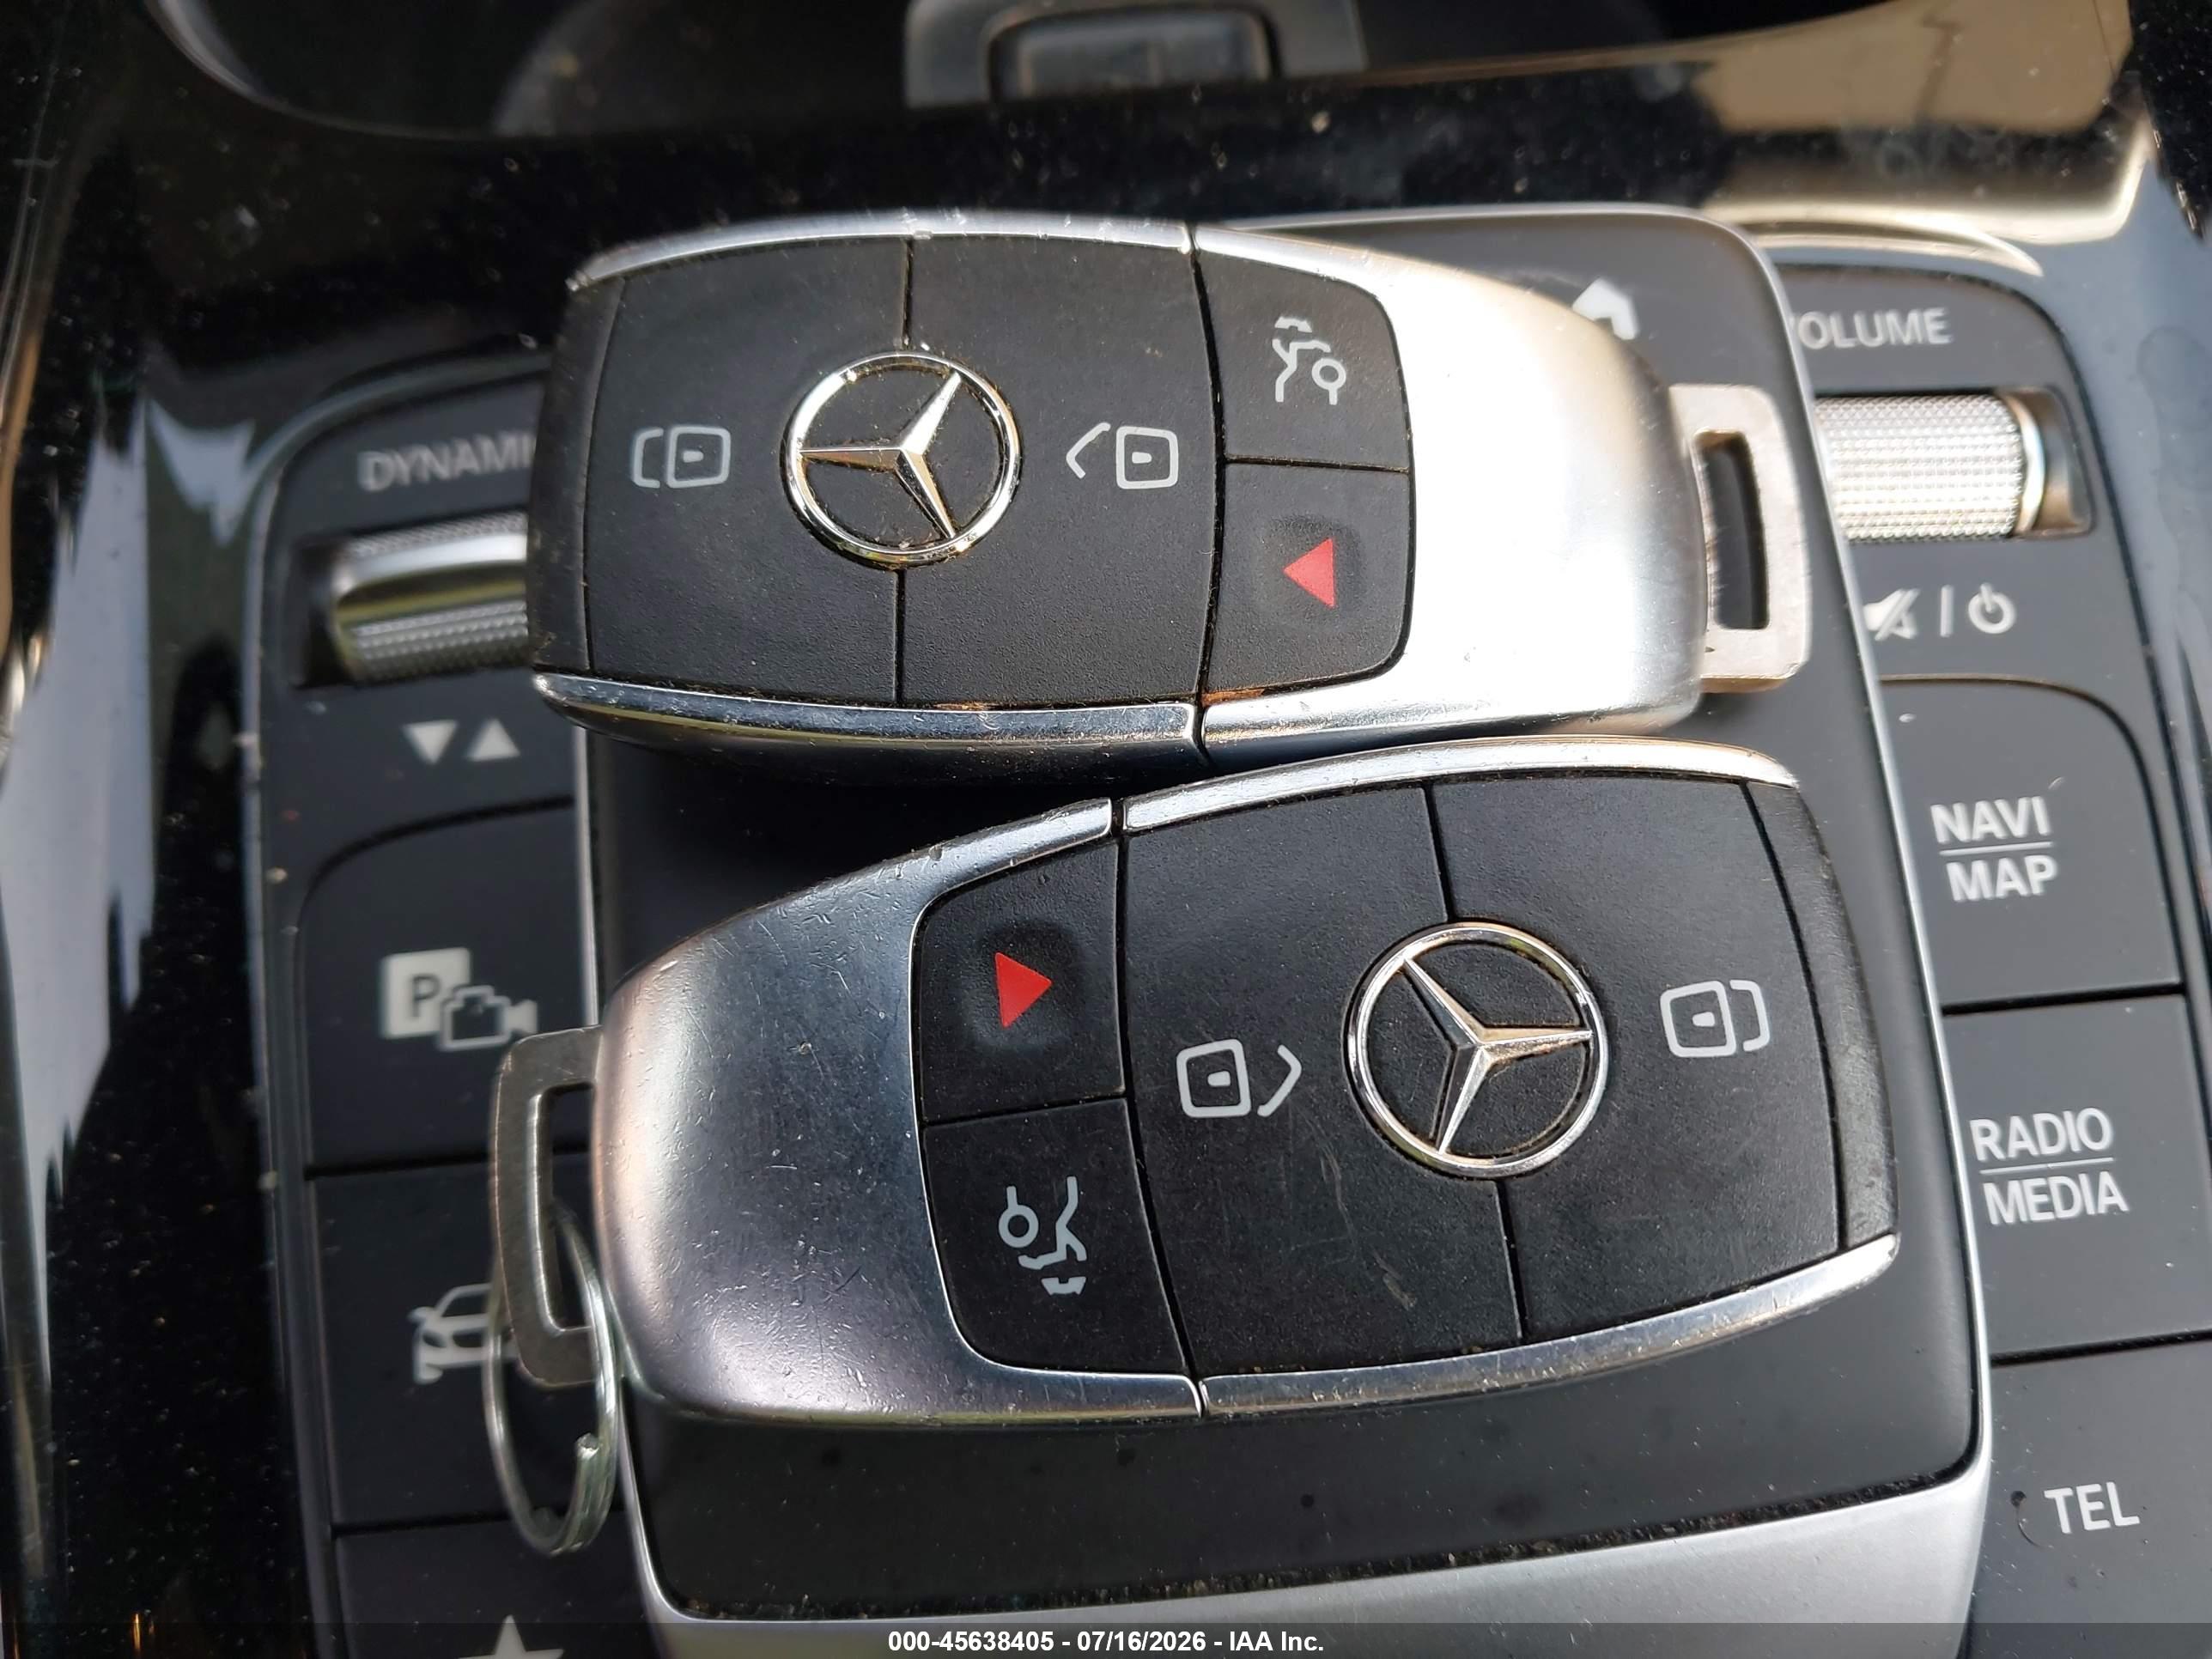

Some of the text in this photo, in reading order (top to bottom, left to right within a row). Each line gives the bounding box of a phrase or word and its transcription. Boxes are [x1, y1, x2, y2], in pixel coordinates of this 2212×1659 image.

[357, 432, 537, 492] DYNAMI
[1930, 795, 2051, 844] NAVI
[1946, 854, 2058, 902] MAP
[410, 974, 441, 1019] P
[1970, 1107, 2113, 1162] RADIO
[1983, 1170, 2130, 1225] MEDIA
[2044, 1481, 2141, 1534] TEL
